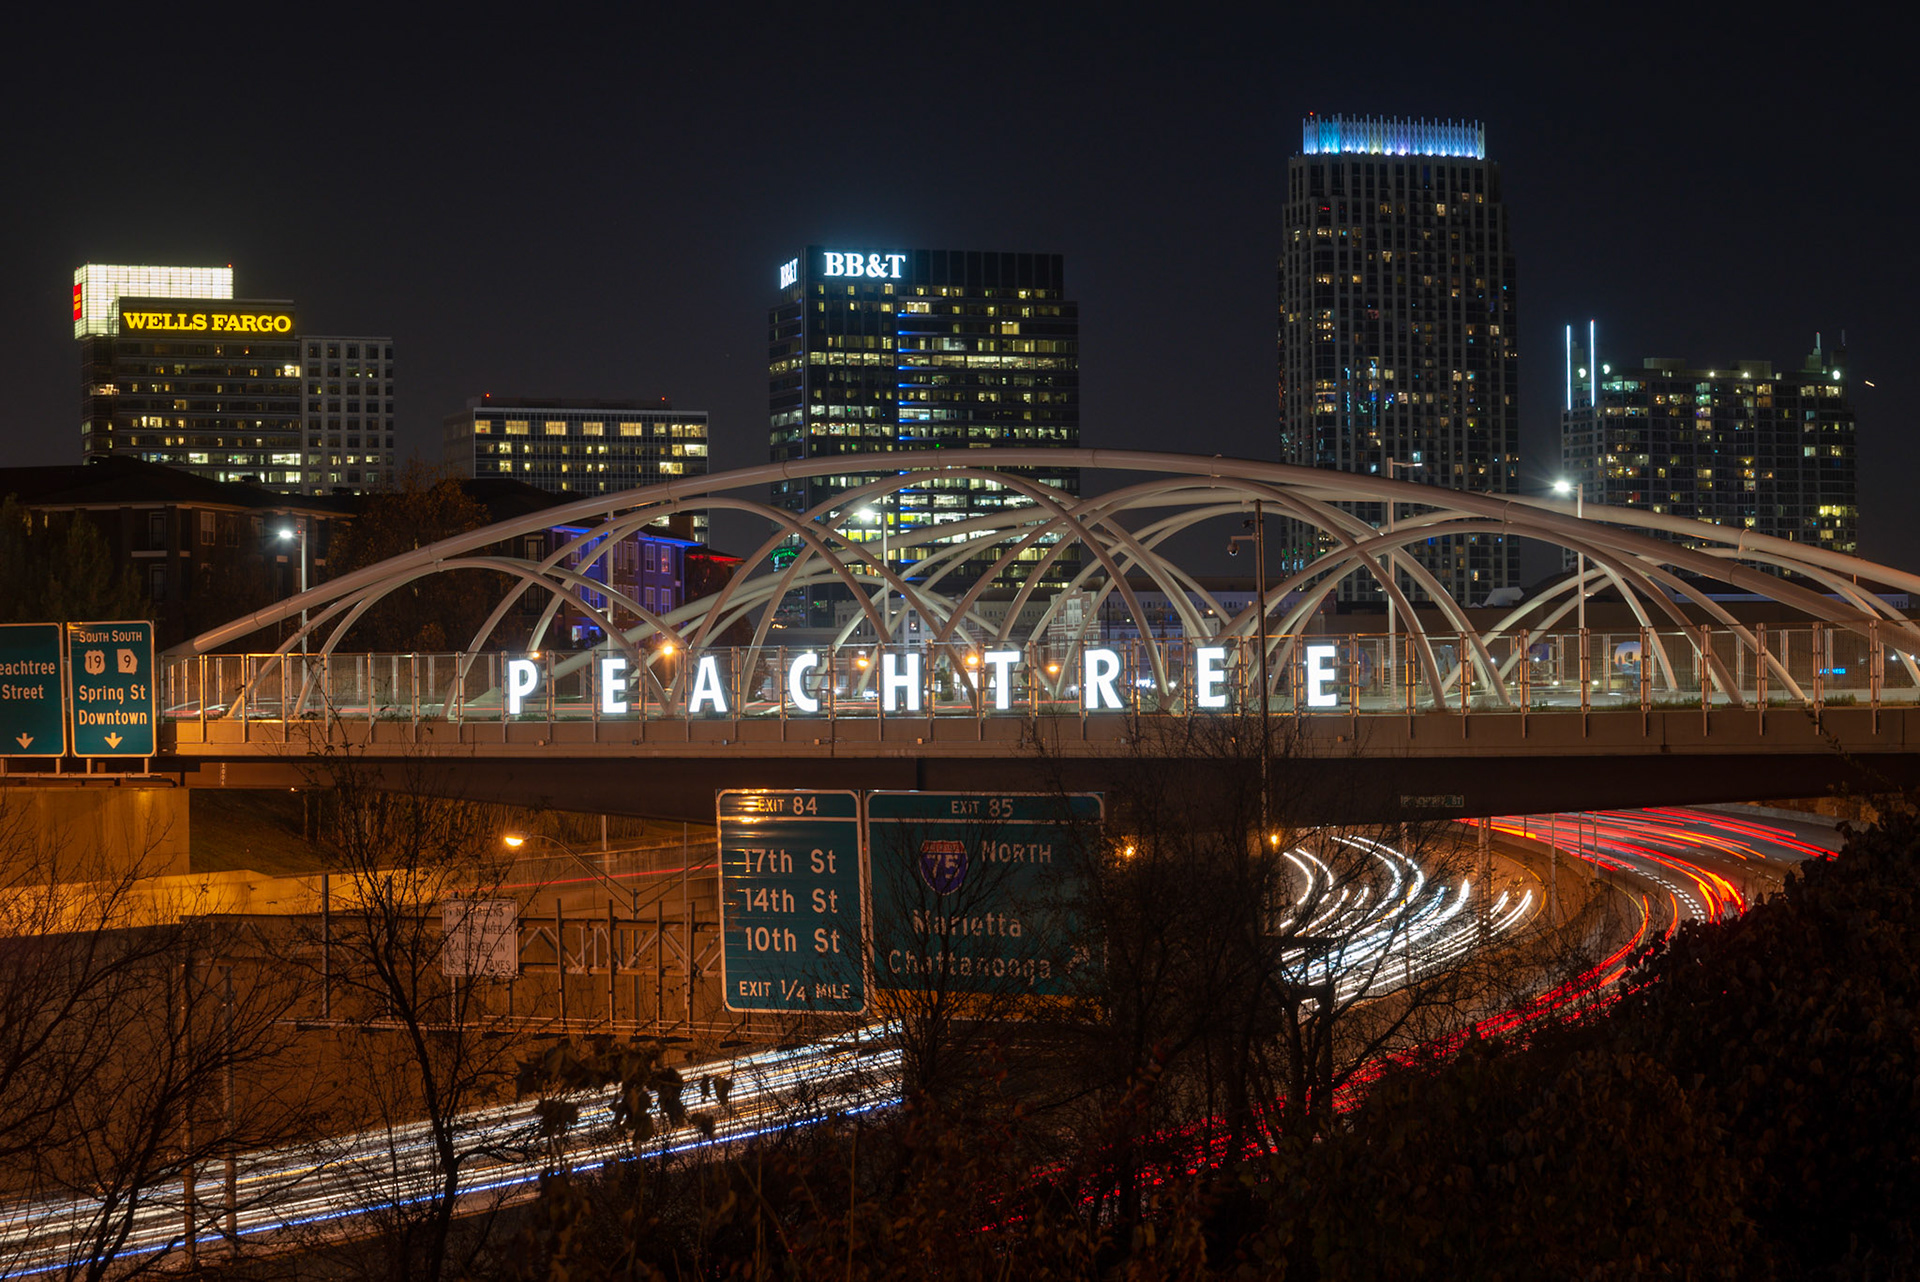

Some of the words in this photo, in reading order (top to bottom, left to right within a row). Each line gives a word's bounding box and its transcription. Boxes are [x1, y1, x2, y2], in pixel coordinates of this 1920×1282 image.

[823, 251, 906, 279] BB&T
[122, 312, 208, 331] WELLS
[211, 314, 292, 333] FARGO
[79, 631, 109, 643] SOUTH
[112, 629, 143, 642] SOUTH
[88, 655, 102, 669] 19
[123, 654, 131, 668] 9
[2, 684, 44, 700] Street
[79, 685, 124, 704] Spring
[130, 684, 146, 700] St
[78, 709, 148, 726] Downtown
[758, 799, 784, 812] EXIT
[793, 796, 818, 815] 84
[951, 800, 980, 814] EXIT
[989, 798, 1014, 818] 85
[743, 848, 793, 873] 17th
[810, 848, 837, 874] St
[982, 840, 1052, 863] NORTH
[927, 854, 960, 879] 75
[744, 887, 795, 913] 14th
[812, 888, 838, 914] St
[745, 926, 796, 952] 10th
[814, 928, 840, 953] St
[739, 980, 771, 997] EXIT
[815, 983, 850, 999] MILE
